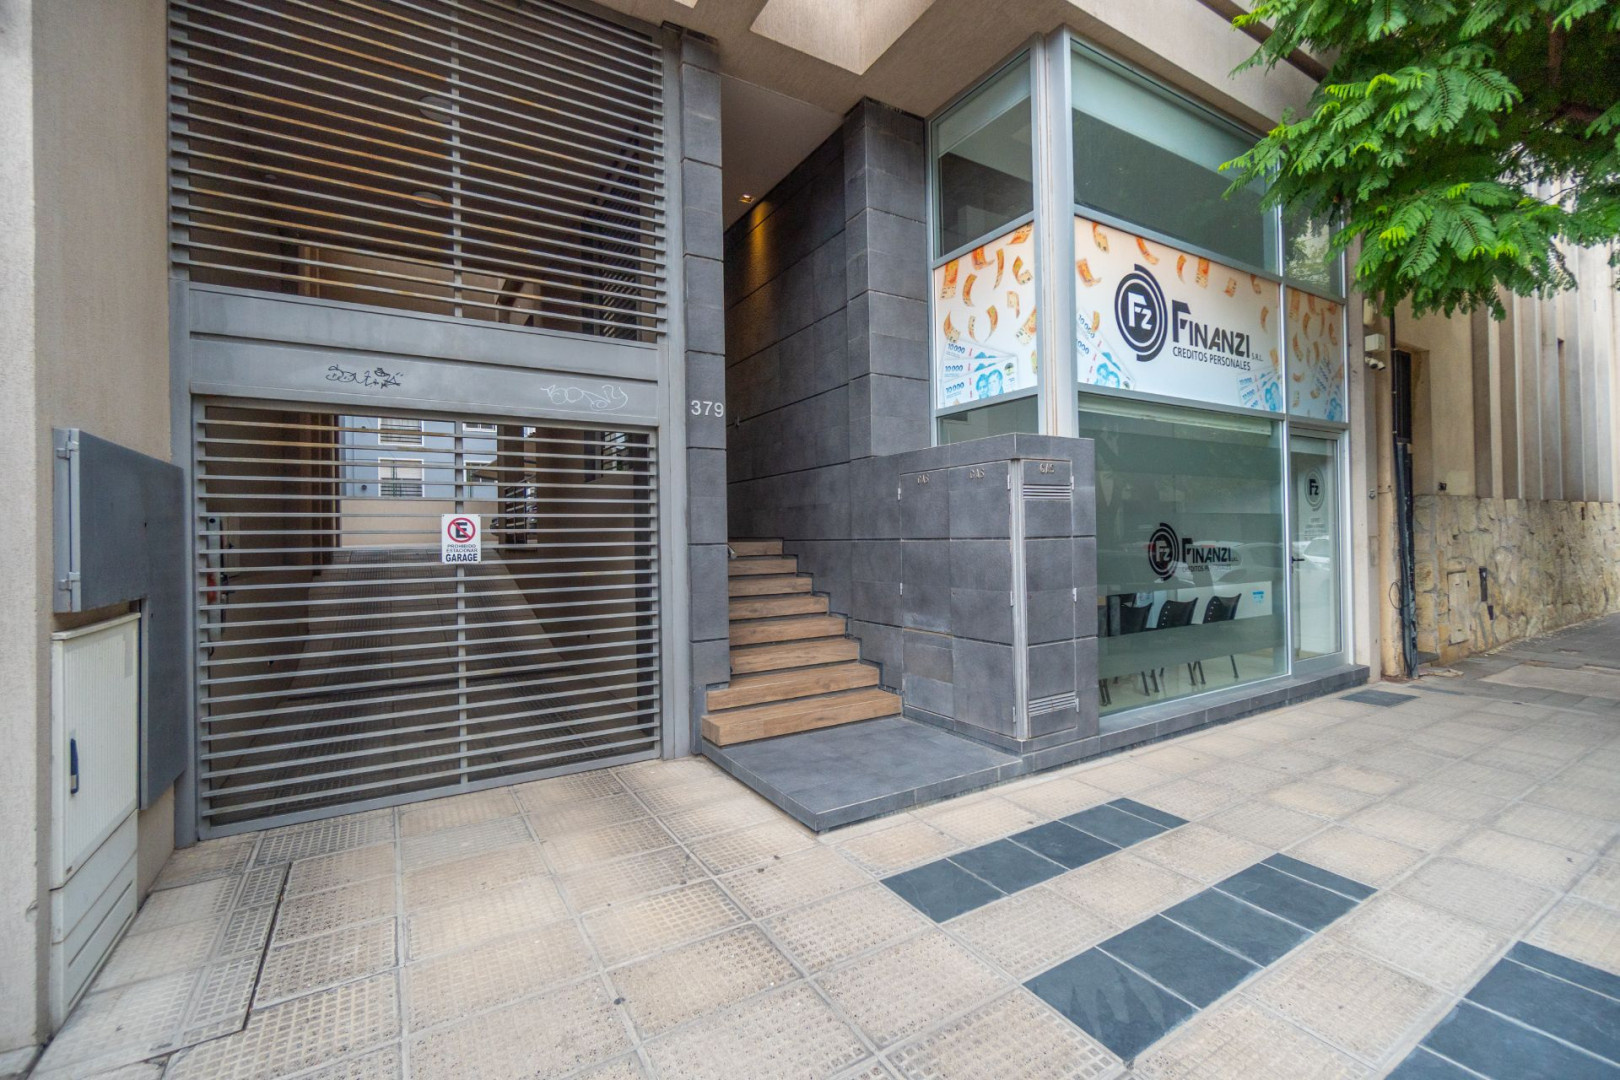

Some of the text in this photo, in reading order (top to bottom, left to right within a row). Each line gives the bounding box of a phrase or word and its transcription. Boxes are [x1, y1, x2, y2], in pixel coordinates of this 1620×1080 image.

[1172, 299, 1250, 358] FINANZI
[1173, 346, 1252, 371] CREDITOS PERSONALES
[691, 400, 724, 418] 379
[455, 521, 468, 539] E
[445, 553, 478, 563] GARAGE
[1181, 537, 1232, 564] FINANZI
